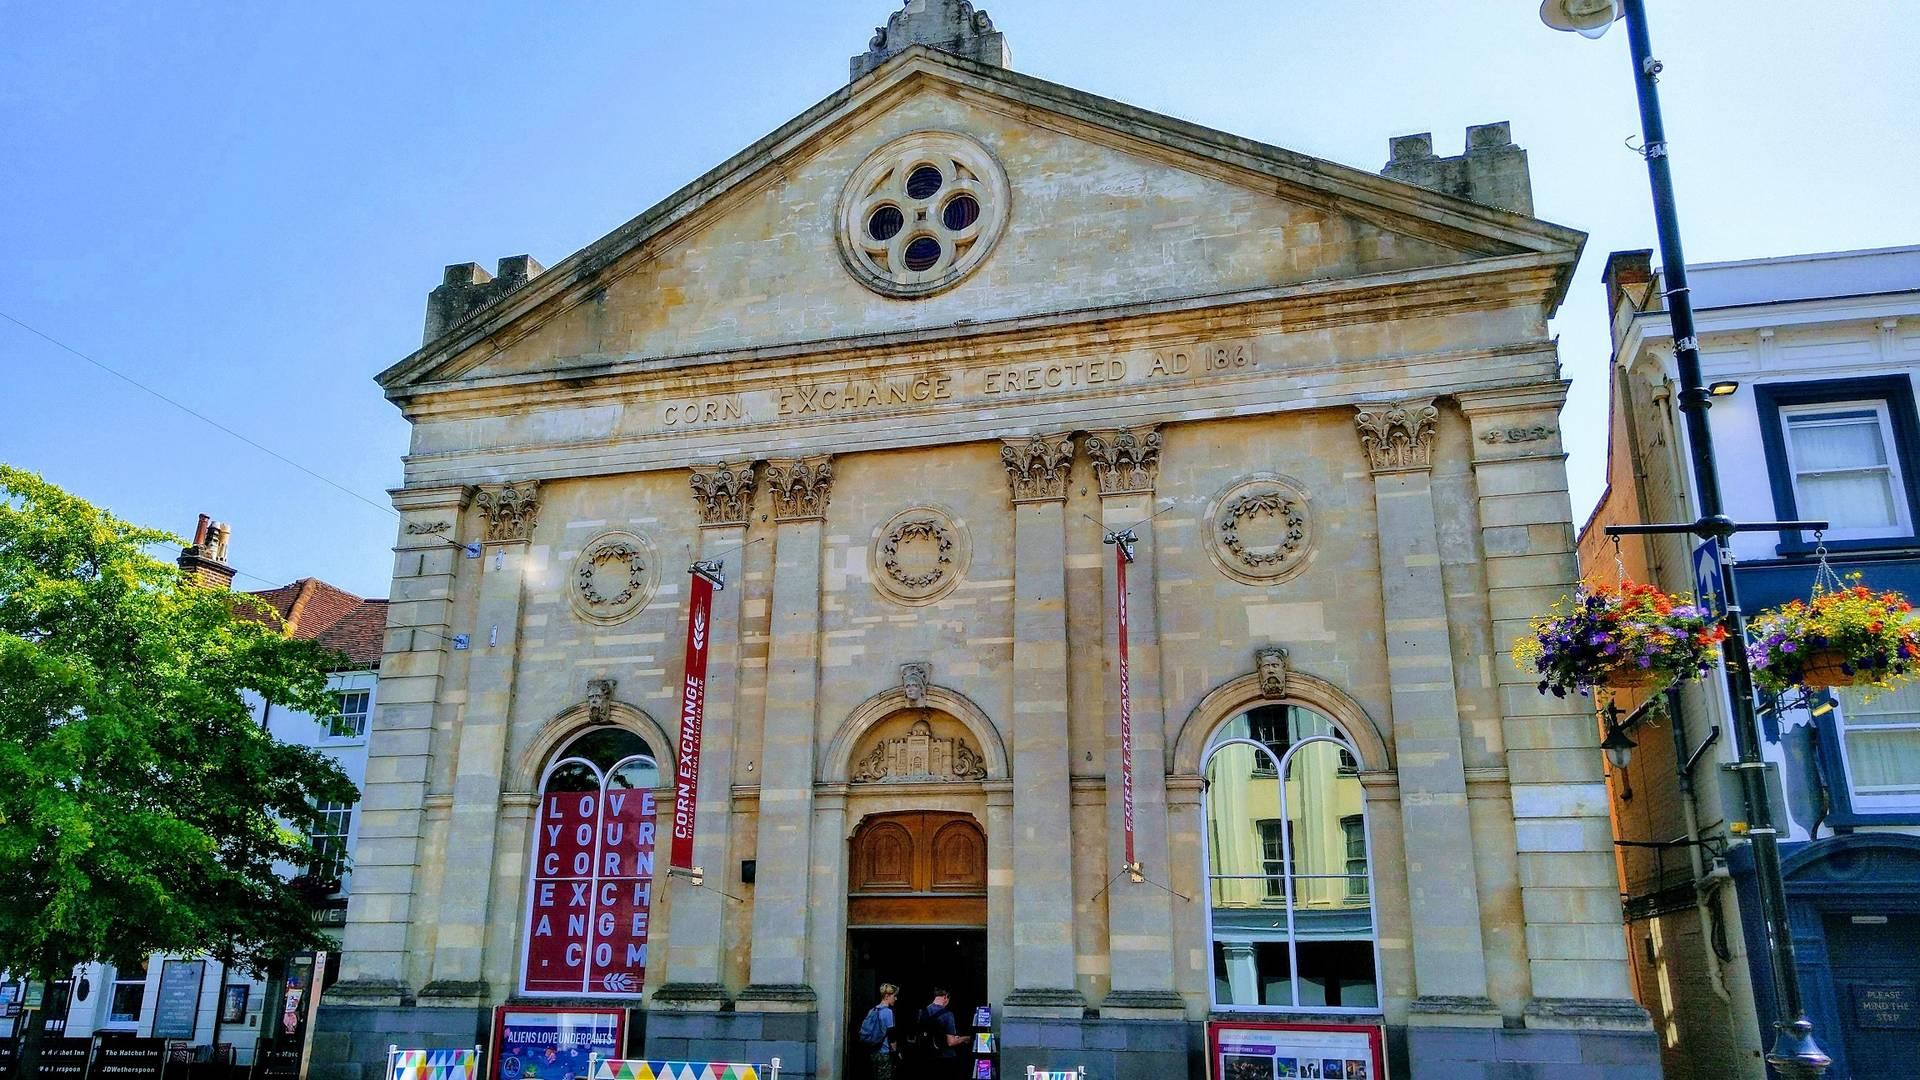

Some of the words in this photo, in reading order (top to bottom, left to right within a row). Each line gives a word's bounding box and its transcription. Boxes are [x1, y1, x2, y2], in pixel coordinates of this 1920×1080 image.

[663, 398, 742, 425] CORN
[777, 377, 951, 415] EXCHANGE
[984, 358, 1127, 394] ERECTED
[1148, 351, 1192, 377] AD
[1205, 343, 1258, 371] 1861
[680, 673, 698, 778] EXCHANGE
[549, 793, 656, 818] LOVE
[675, 783, 690, 839] CORN
[687, 801, 695, 839] THEATRE
[547, 822, 655, 846] YOUR
[543, 852, 654, 875] CORN
[540, 883, 651, 907] EXCH
[311, 908, 347, 921] WE
[535, 912, 648, 936] ANGE
[1863, 1002, 1889, 1010] MIND
[1891, 1002, 1910, 1010] THE
[1866, 991, 1903, 999] PLEASE
[507, 1031, 536, 1043] ALIENS
[537, 1032, 558, 1044] LOVE
[558, 1032, 613, 1045] UNDERPANTS
[102, 1066, 155, 1074] JDWetherspoon
